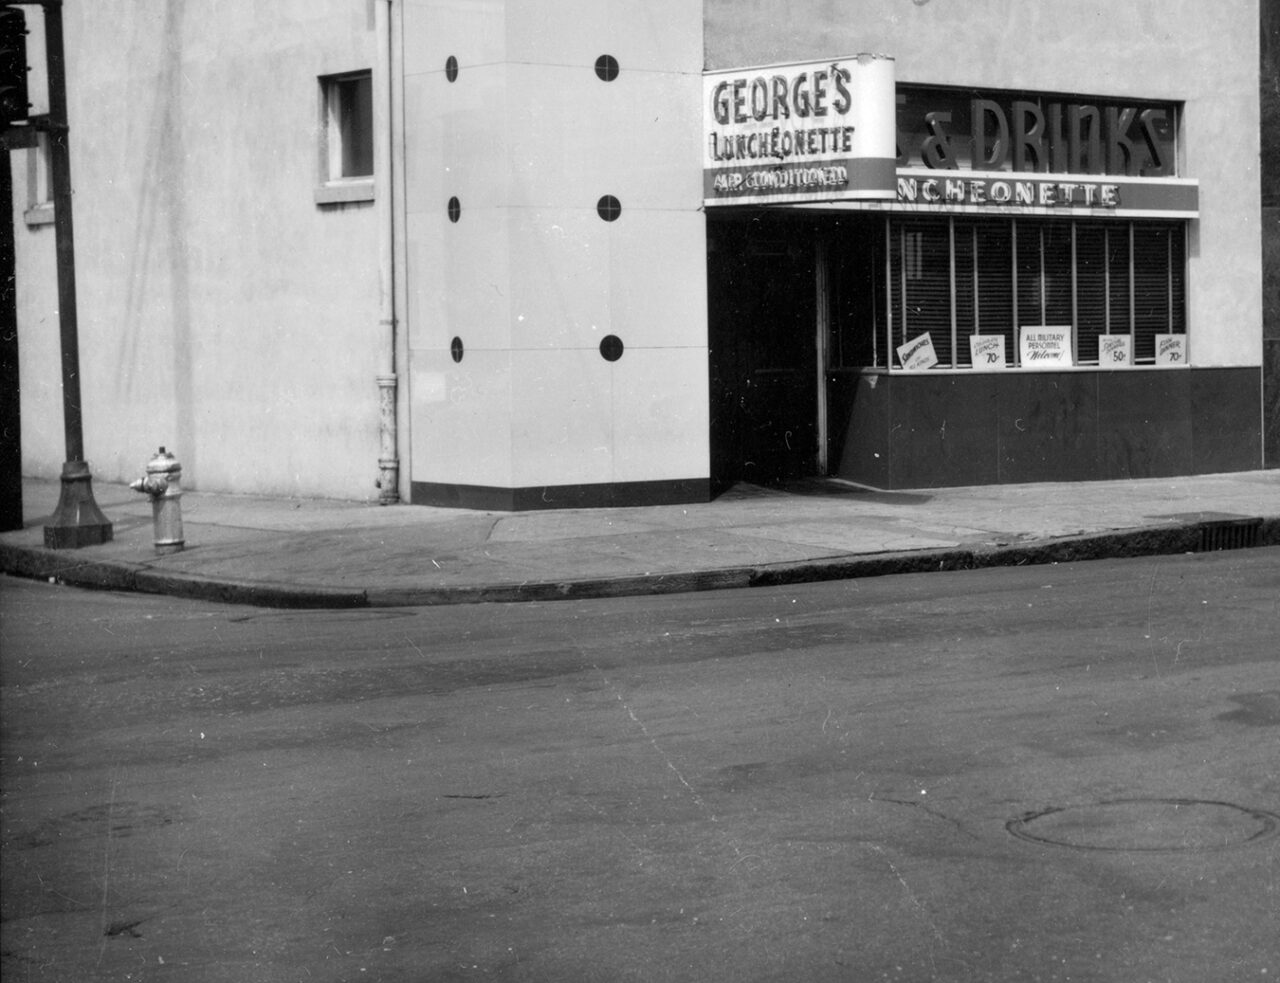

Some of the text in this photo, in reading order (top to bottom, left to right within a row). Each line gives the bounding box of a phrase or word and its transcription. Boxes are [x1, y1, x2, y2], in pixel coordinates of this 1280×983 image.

[712, 64, 853, 126] GEORGE'S
[710, 126, 856, 162] LUNCHEONETTE
[970, 99, 1167, 178] DRINKS
[1026, 333, 1036, 341] ALL
